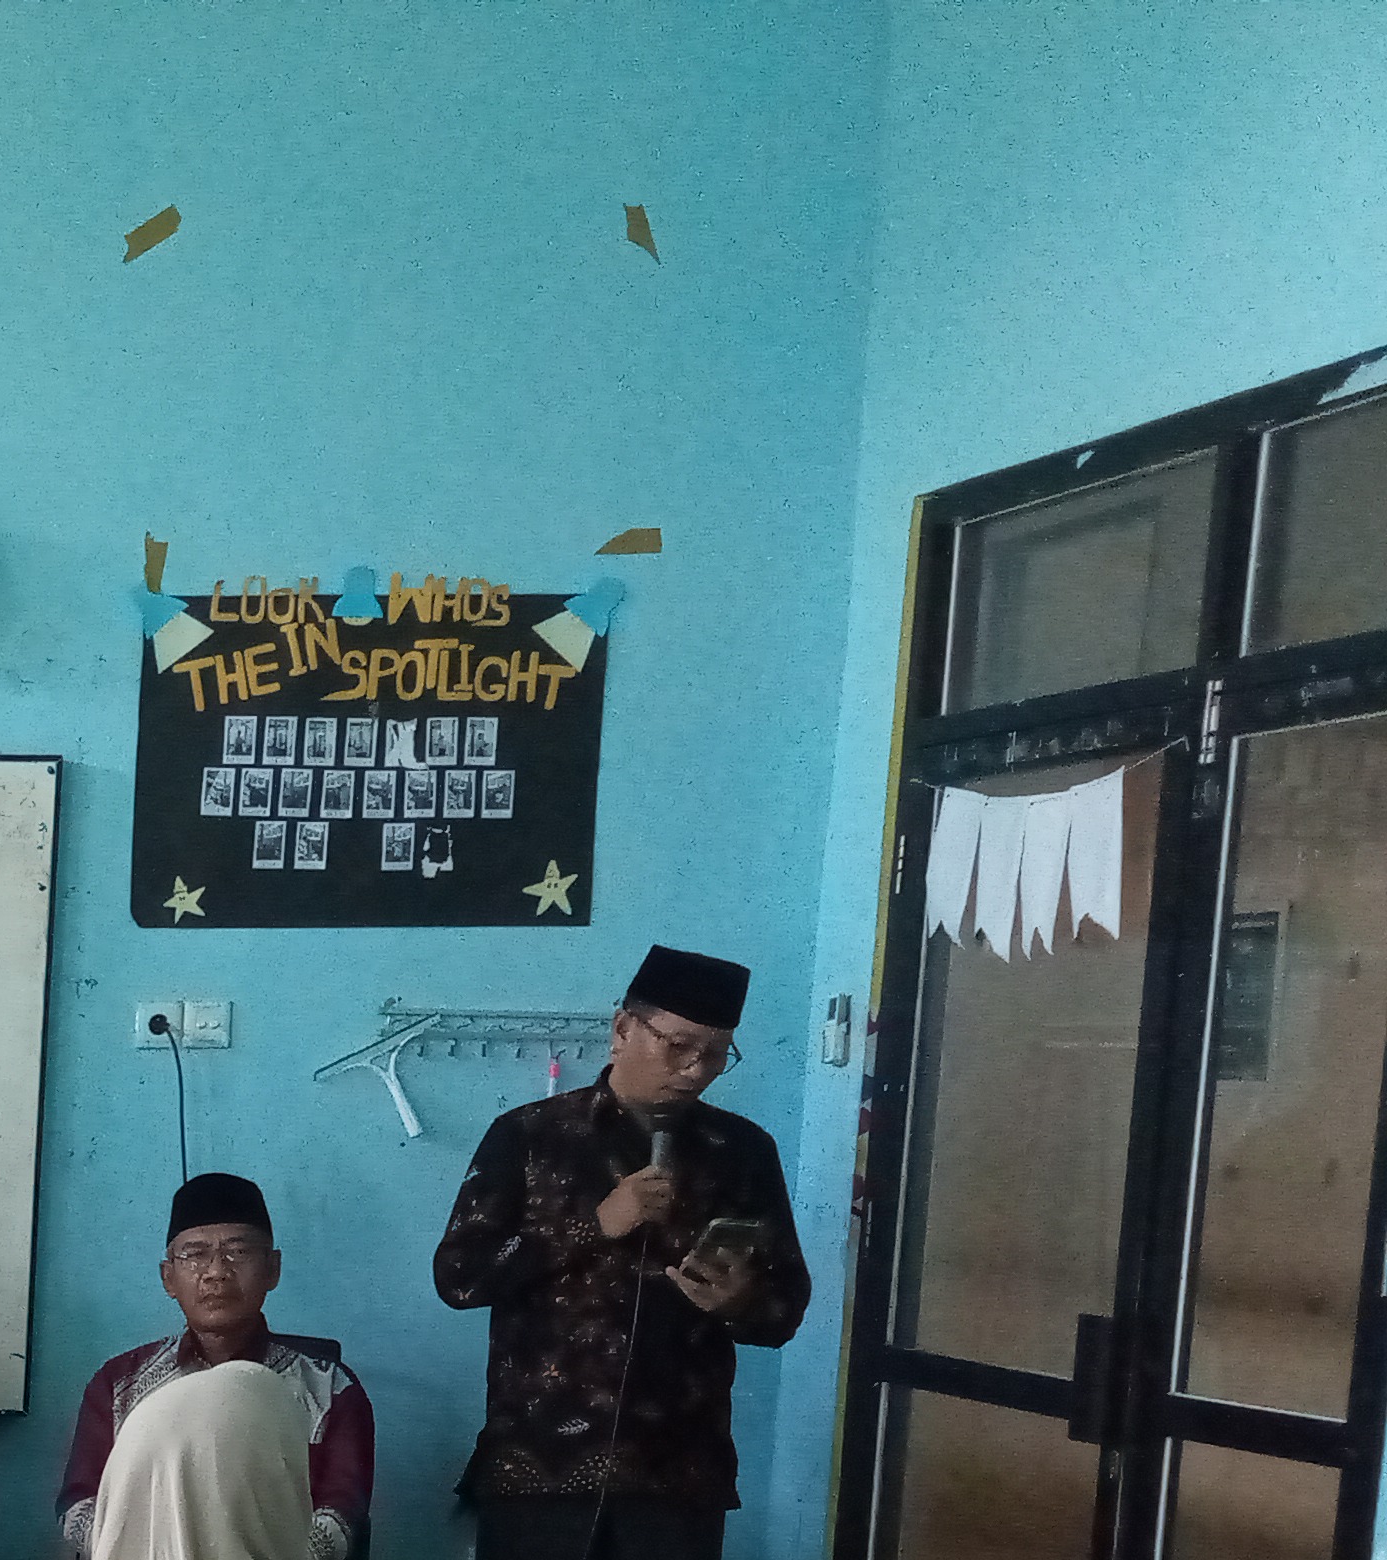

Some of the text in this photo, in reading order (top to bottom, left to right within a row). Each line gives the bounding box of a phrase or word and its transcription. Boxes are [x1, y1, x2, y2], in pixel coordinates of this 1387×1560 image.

[209, 571, 511, 627] LOOK WHOS
[172, 637, 576, 712] THE SPOTLIGHT
[280, 618, 343, 677] IN
